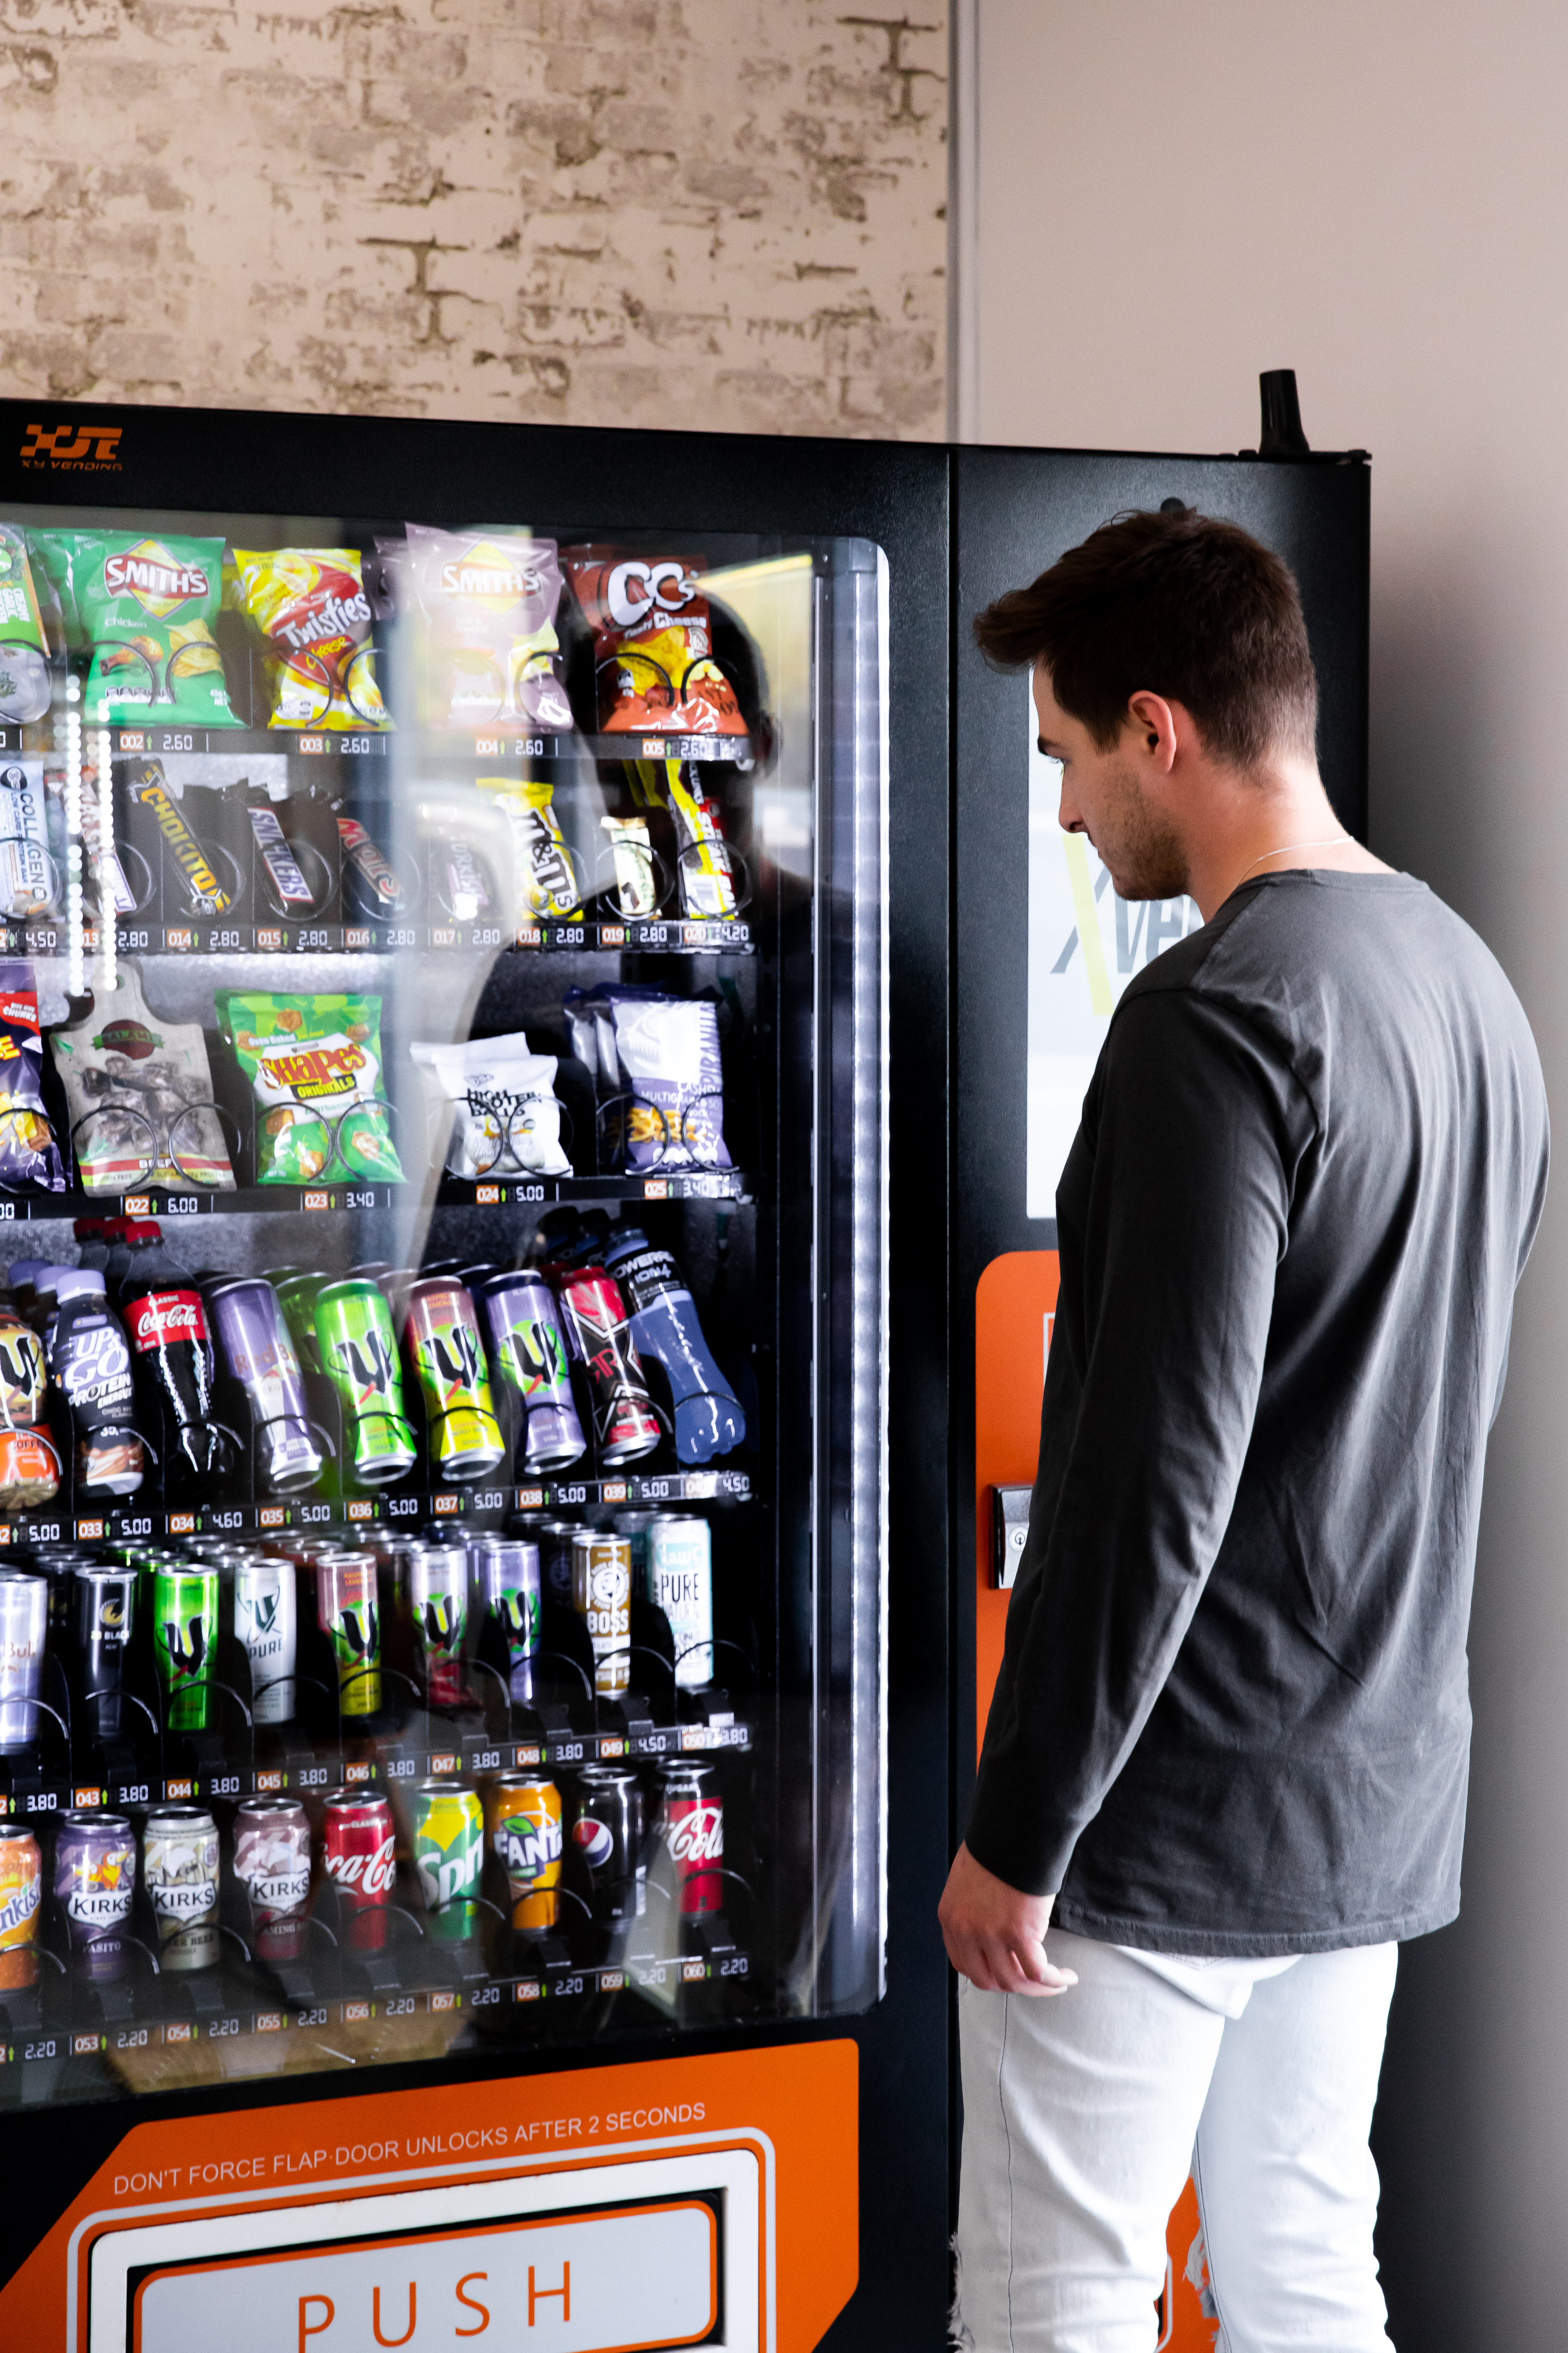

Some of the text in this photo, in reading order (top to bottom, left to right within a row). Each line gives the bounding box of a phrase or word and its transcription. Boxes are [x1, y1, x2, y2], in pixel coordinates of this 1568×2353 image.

[52, 461, 123, 471] VENDING
[107, 558, 207, 593] SMITH'S
[105, 617, 147, 628] Chicken
[276, 593, 371, 648] Twisties
[121, 734, 193, 750] 002 2.60
[301, 738, 370, 753] 003 2.60
[476, 739, 544, 755] 004 2.60
[643, 742, 708, 756] 005 2.60
[20, 793, 45, 884] COLLGEN
[25, 931, 56, 948] 4.50
[79, 931, 148, 947] 13 2.80
[169, 931, 239, 948] 014 2.80
[258, 930, 328, 947] 015 2.80
[347, 930, 415, 946] 016 2.80
[434, 929, 500, 945] 017 2.80
[518, 928, 584, 944] 018 2.80
[602, 927, 667, 942] 019 2.80
[722, 925, 749, 941] 4.20
[477, 1186, 544, 1202] 024 5.00
[645, 1182, 667, 1196] 025
[125, 1197, 198, 1214] 022 6.00
[305, 1192, 374, 1208] 023 3.40
[604, 1485, 626, 1500] 039
[641, 1481, 669, 1498] 5.00
[723, 1475, 750, 1492] 4.50
[436, 1492, 502, 1510] 037 5.00
[520, 1486, 586, 1505] 038 5.00
[261, 1505, 330, 1524] 035 5.00
[350, 1498, 418, 1517] 036 5.00
[79, 1518, 151, 1537] 033 5.00
[171, 1511, 243, 1531] 034 4.60
[29, 1523, 60, 1541] 5.00
[662, 1573, 699, 1602] PURE
[587, 1609, 629, 1634] BOSS
[517, 1743, 583, 1764] 048 3.80
[601, 1735, 666, 1756] 049 4.50
[346, 1760, 415, 1780] 046 3.80
[432, 1752, 500, 1772] 047 3.80
[168, 1777, 240, 1797] 044 3.80
[258, 1768, 327, 1788] 045 3.80
[27, 1793, 57, 1812] 3.80
[76, 1785, 149, 1805] 043 3.80
[154, 1887, 214, 1908] KIRKS
[254, 1877, 309, 1899] KIRKS
[74, 1895, 132, 1915] KIRKS
[683, 1958, 748, 1979] 060 2.20
[517, 1977, 583, 1999] 058 2.20
[601, 1968, 666, 1989] 059 2.20
[432, 1988, 500, 2009] 057 2.20
[346, 1998, 415, 2020] 056 2.20
[258, 2008, 327, 2030] 055 2.20
[167, 2019, 239, 2041] 054 2.20
[75, 2029, 148, 2052] 053 2.20
[25, 2041, 56, 2060] 2.20
[114, 2103, 706, 2194] DON'T FORCE FLAP DOOR UNLOCKS AFTER 2 SECONDS
[298, 2261, 571, 2353] PUSH
